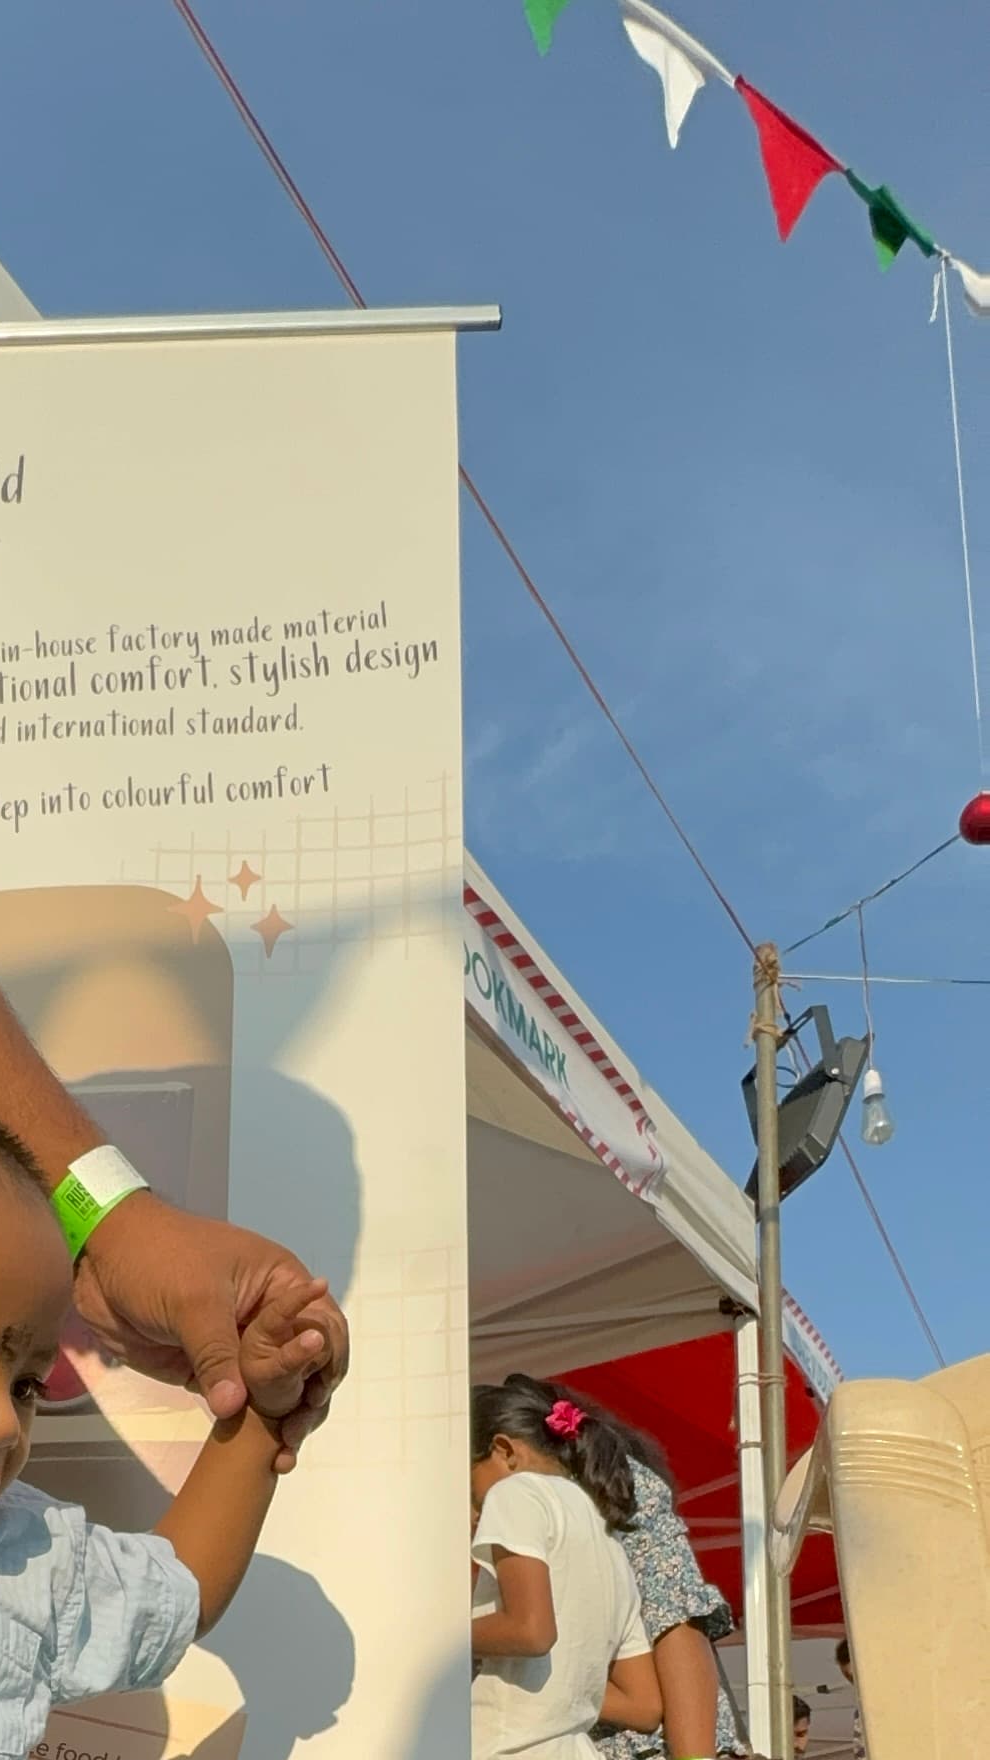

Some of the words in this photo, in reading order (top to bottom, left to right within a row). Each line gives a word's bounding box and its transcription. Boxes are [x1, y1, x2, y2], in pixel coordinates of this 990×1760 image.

[1, 629, 98, 664] in-house
[106, 624, 200, 660] factory
[210, 615, 273, 647] made
[283, 600, 388, 640] material
[229, 640, 331, 697] stylish
[345, 638, 439, 680] design
[17, 706, 176, 743] international
[185, 702, 305, 737] standard.
[40, 783, 91, 816] into
[101, 771, 215, 810] colourful
[226, 763, 332, 803] comfort
[464, 939, 571, 1092] OKMARK
